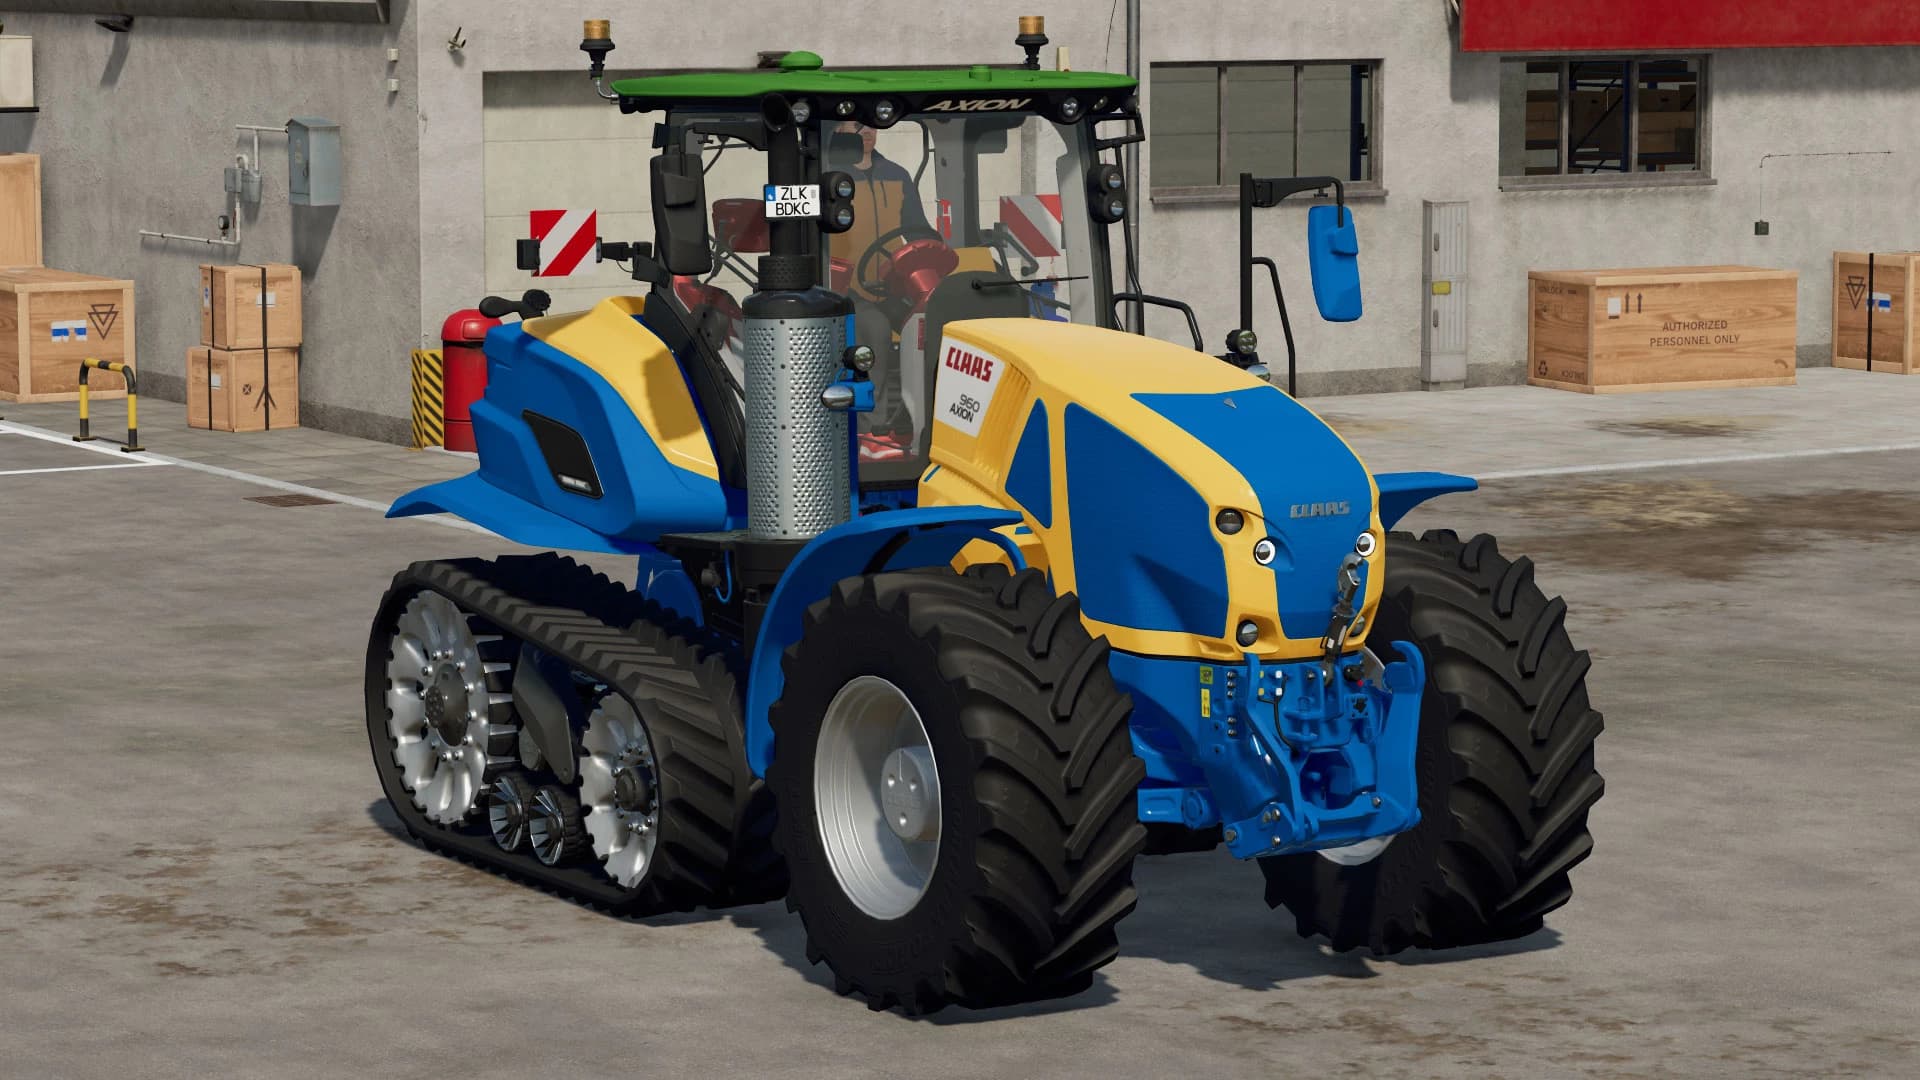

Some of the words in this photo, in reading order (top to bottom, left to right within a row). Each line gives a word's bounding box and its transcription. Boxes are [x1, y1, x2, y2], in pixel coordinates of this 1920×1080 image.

[922, 98, 1032, 111] AXION
[781, 187, 807, 200] ZLK
[775, 202, 810, 216] BDKC
[1662, 320, 1728, 332] AUTHORIZED
[1649, 335, 1711, 347] PERSONNEL
[1714, 334, 1740, 345] ONLY
[945, 346, 994, 383] CLAAS
[959, 394, 980, 413] 960
[949, 403, 974, 423] AXION
[1289, 501, 1350, 518] CLAAS
